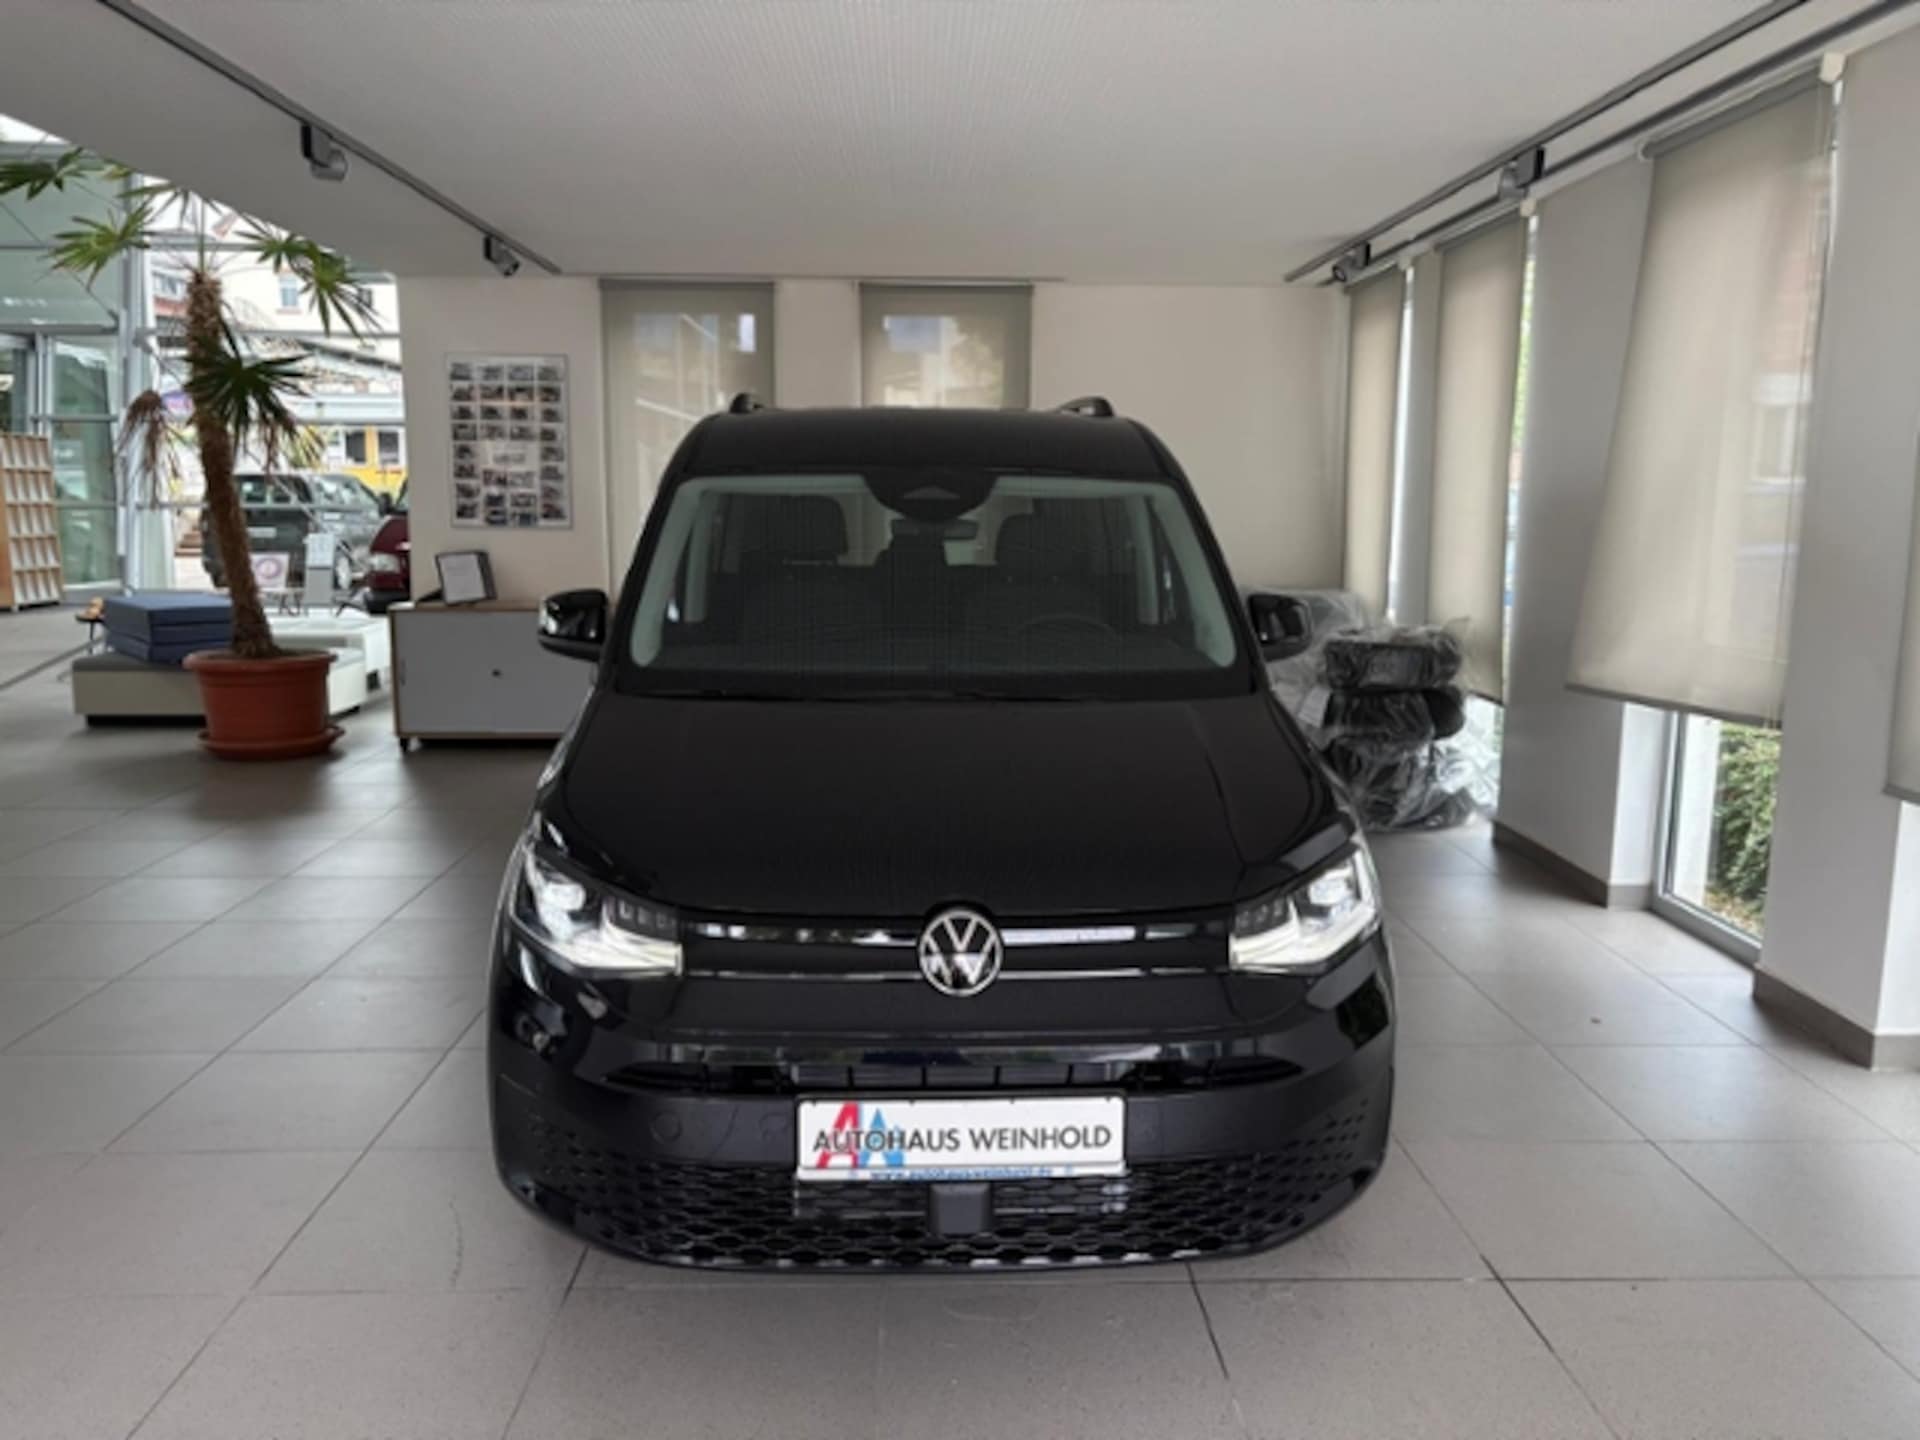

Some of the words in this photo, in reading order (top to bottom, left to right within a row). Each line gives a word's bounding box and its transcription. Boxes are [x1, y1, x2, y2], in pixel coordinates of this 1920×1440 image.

[922, 913, 999, 992] VW
[814, 1127, 960, 1151] AUTOHAUS
[969, 1126, 1111, 1150] WEINHOLD
